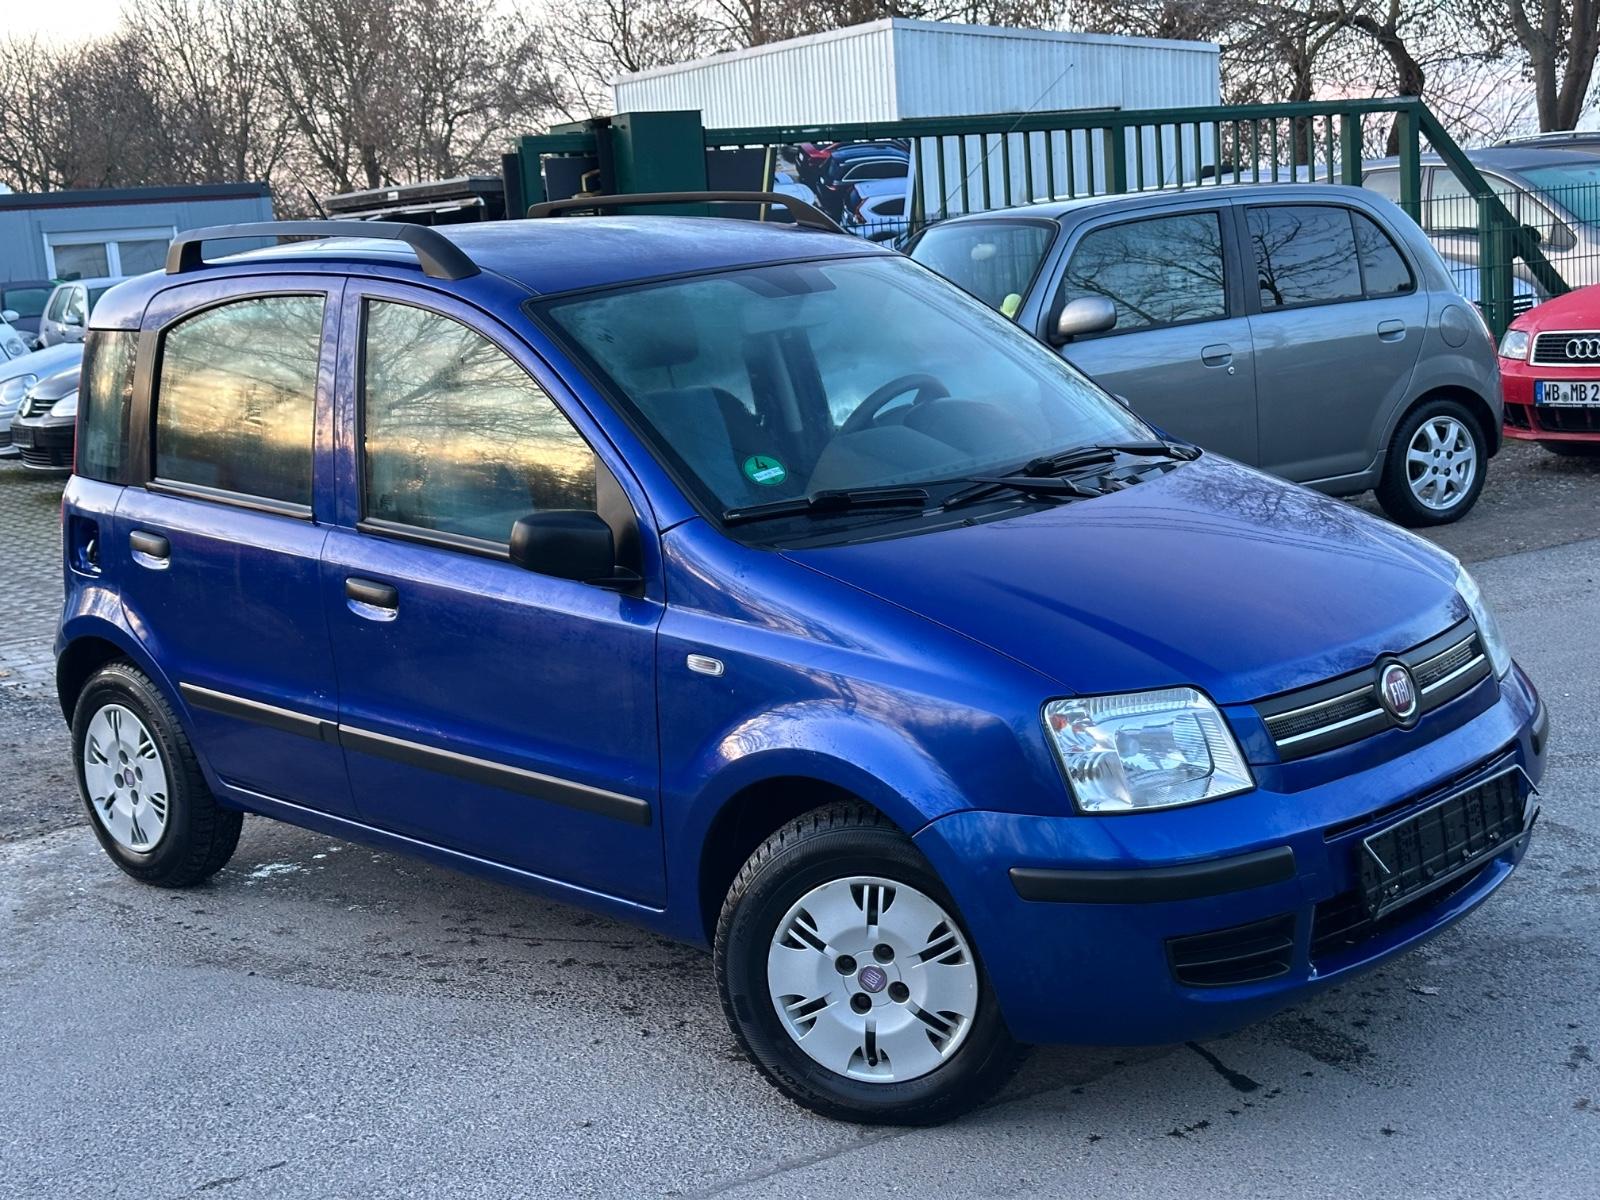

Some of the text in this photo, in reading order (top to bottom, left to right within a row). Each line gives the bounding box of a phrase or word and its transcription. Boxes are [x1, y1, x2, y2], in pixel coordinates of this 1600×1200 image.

[1544, 384, 1560, 401] WB
[1570, 384, 1587, 401] MB
[754, 457, 769, 470] 4
[1389, 677, 1410, 707] FIAT
